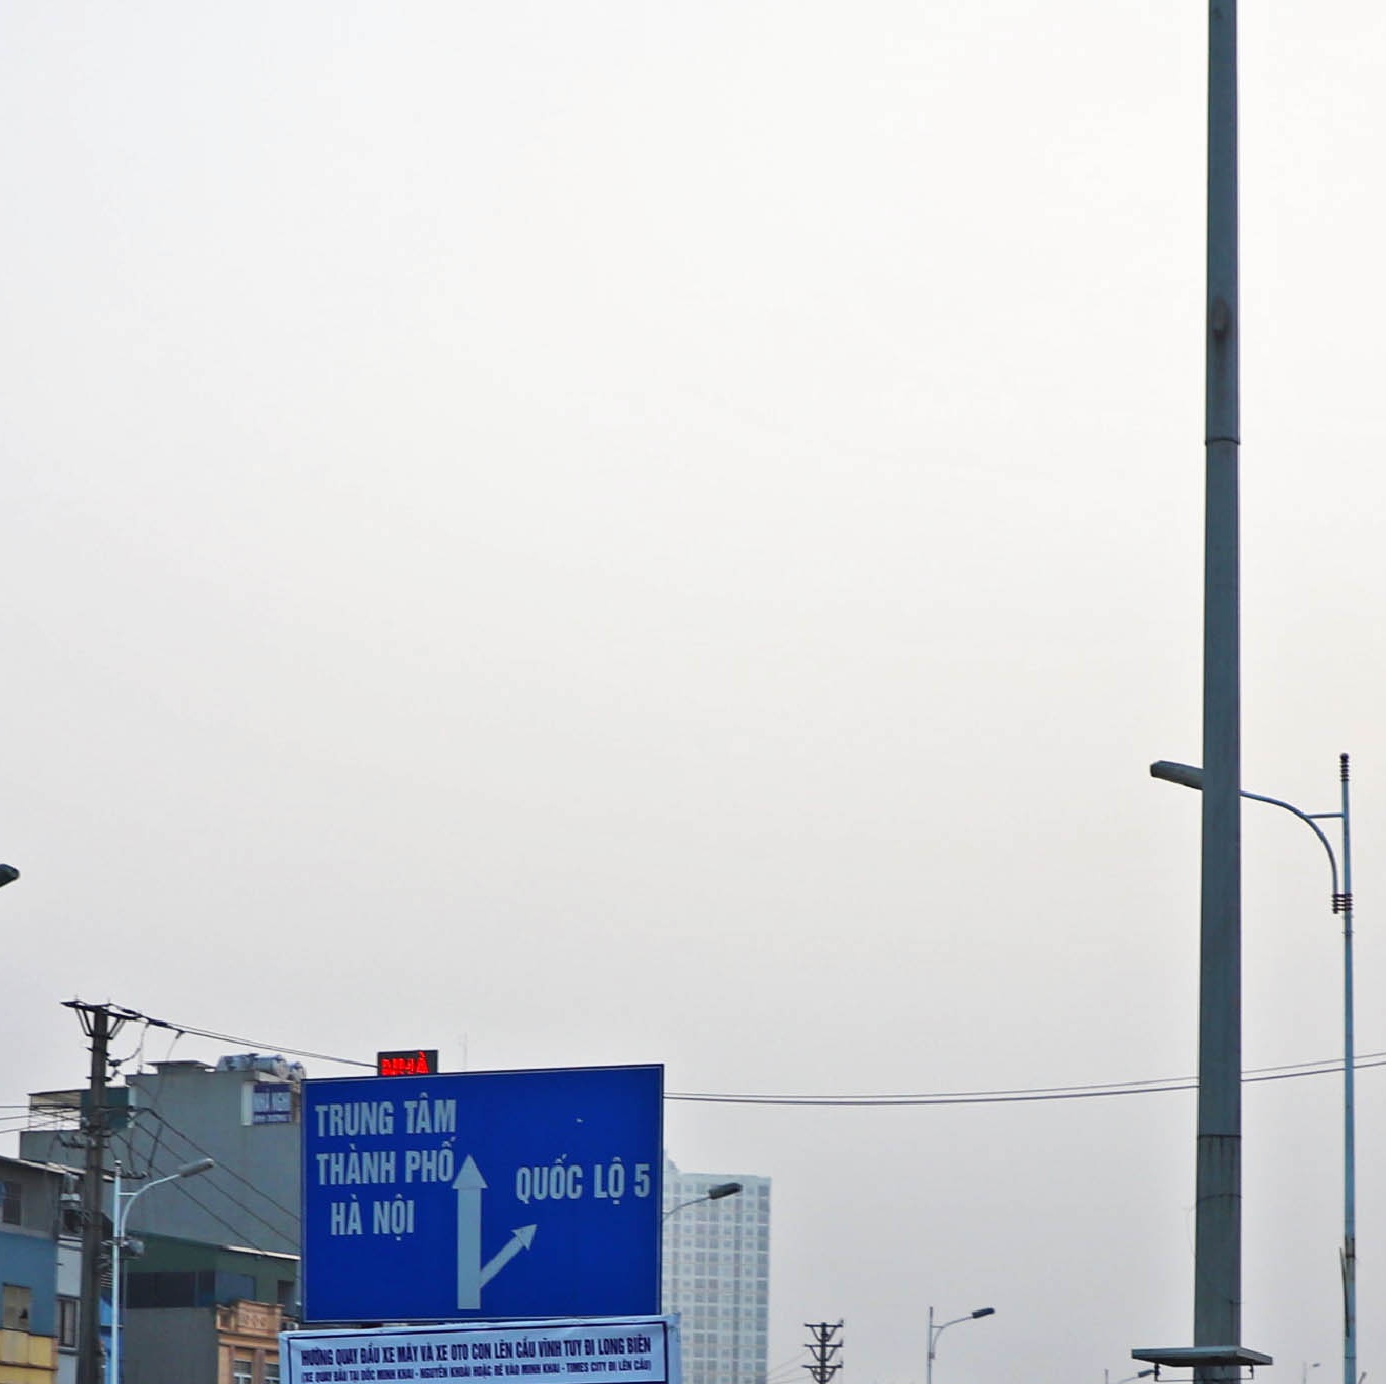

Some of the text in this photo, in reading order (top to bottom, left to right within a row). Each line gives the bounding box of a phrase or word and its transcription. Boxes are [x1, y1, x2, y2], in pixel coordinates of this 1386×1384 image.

[315, 1100, 395, 1138] TRUNG
[404, 1092, 457, 1135] TÂM
[316, 1137, 457, 1186] THÀNH PHỐ
[515, 1154, 652, 1206] QUỐC LỘ 5
[330, 1193, 415, 1242] HÀ NỘI
[382, 1346, 396, 1363] XE
[435, 1344, 448, 1361] XE
[472, 1343, 492, 1360] CON
[563, 1339, 582, 1356] TUY
[584, 1338, 595, 1356] ĐI
[597, 1337, 625, 1356] LONG
[626, 1333, 651, 1354] BIÊN
[566, 1362, 589, 1373] TIMES
